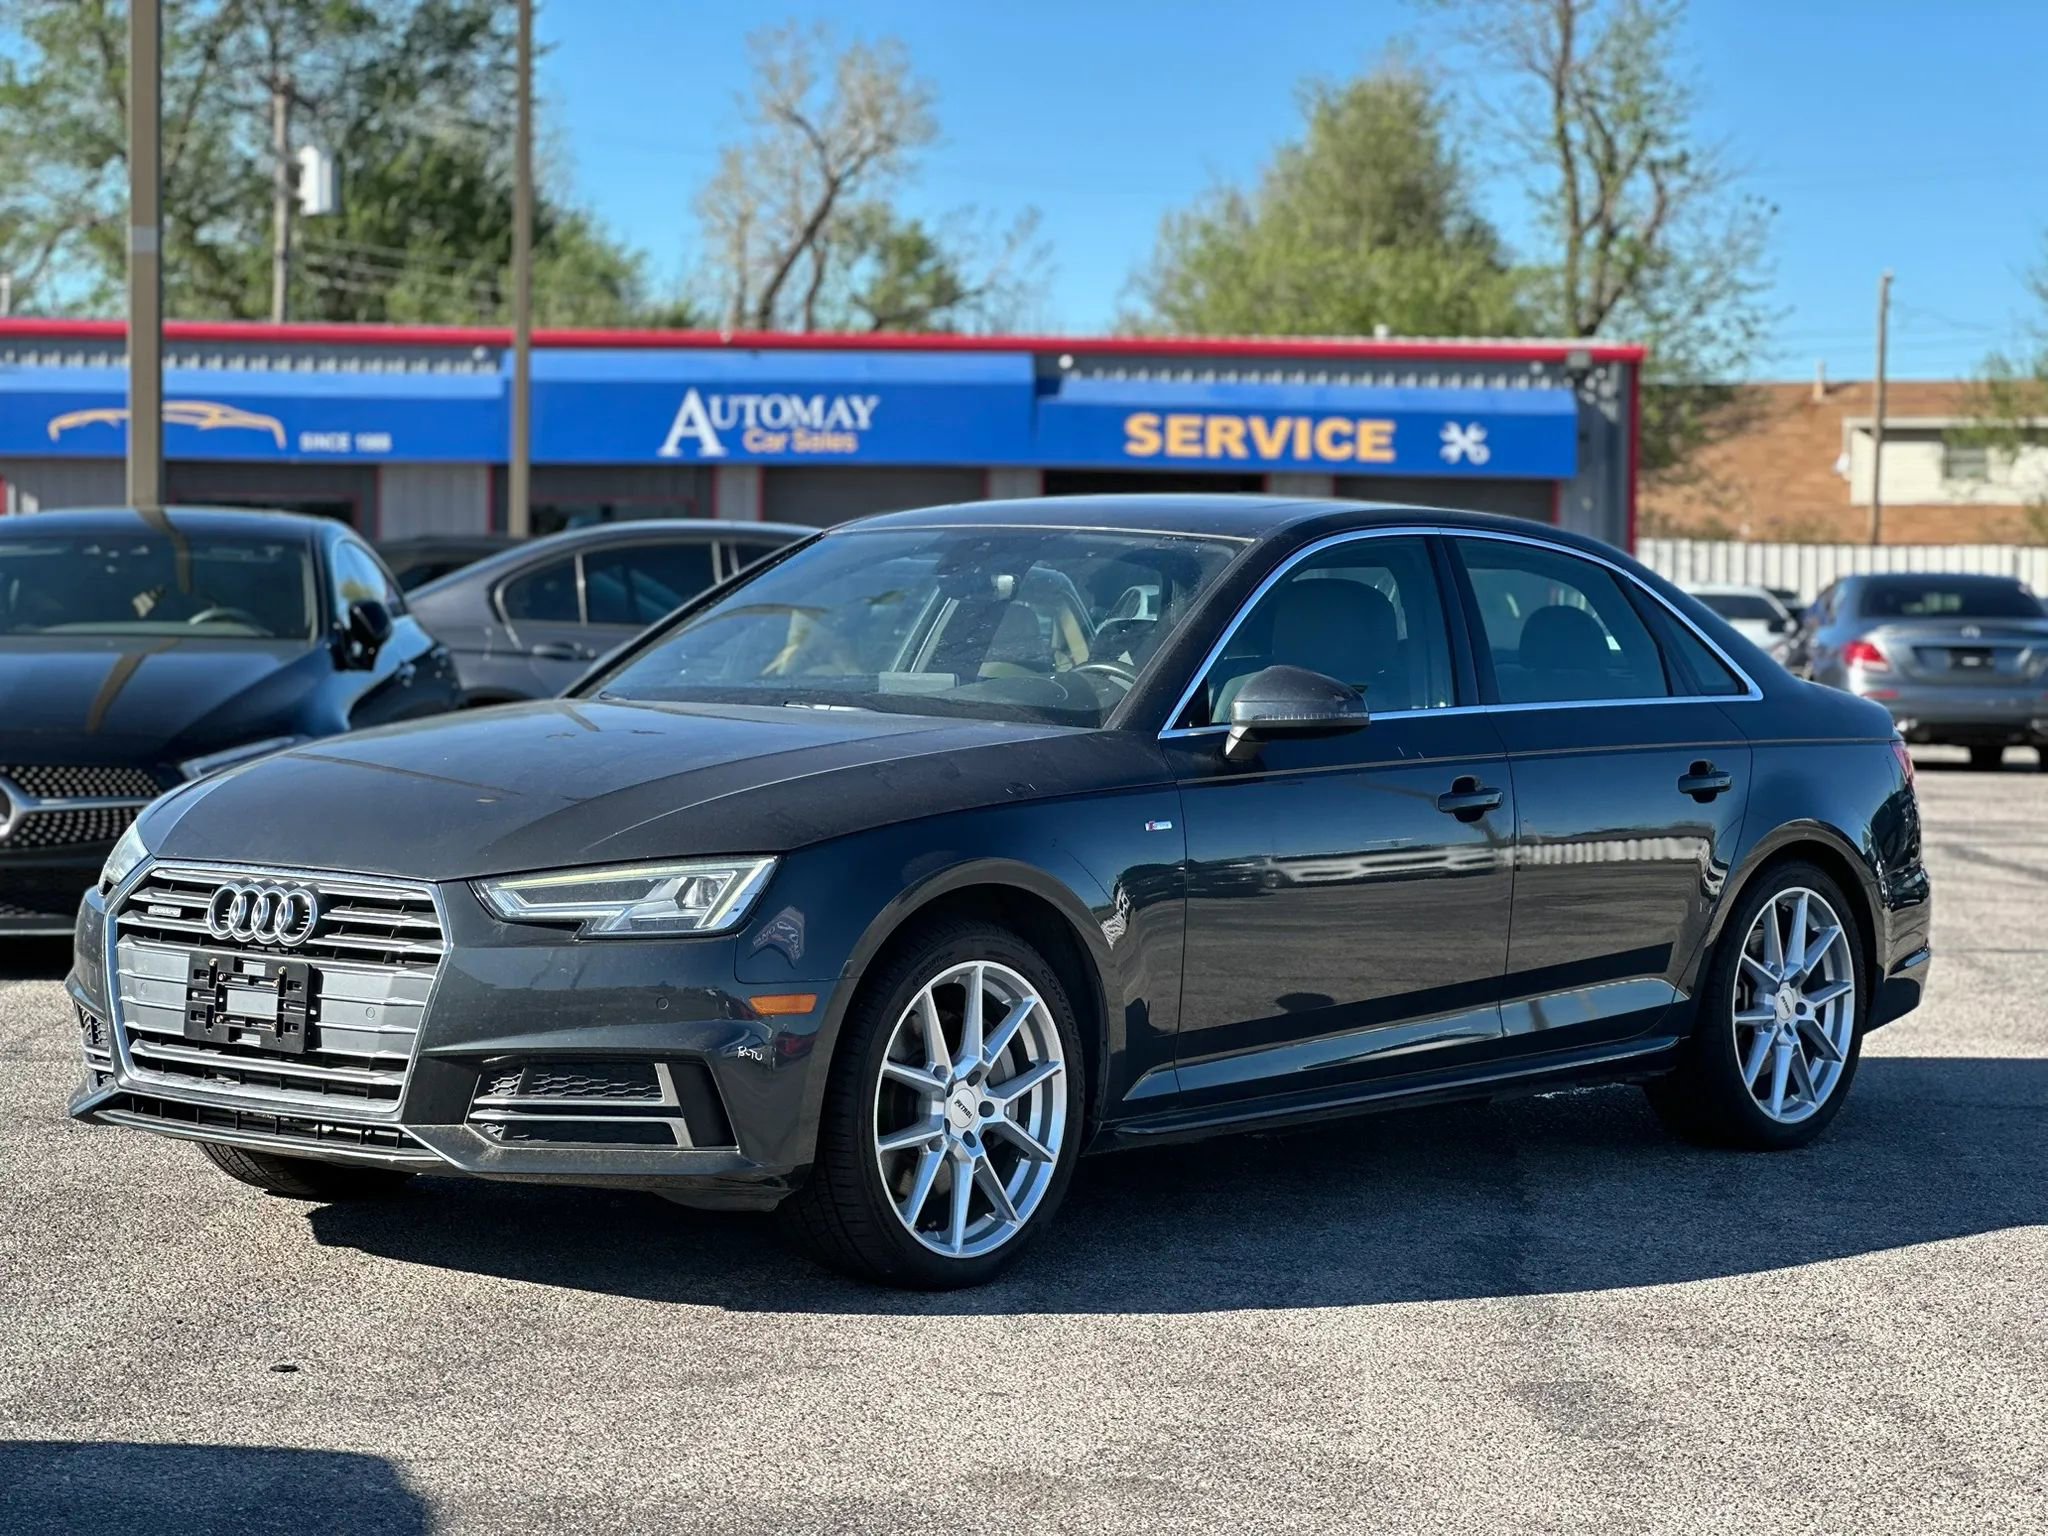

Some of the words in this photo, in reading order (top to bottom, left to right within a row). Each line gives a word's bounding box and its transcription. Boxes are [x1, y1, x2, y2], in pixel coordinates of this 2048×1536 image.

[658, 387, 879, 457] AUTOMAY
[742, 430, 787, 453] Car
[791, 428, 858, 453] Sales
[1125, 413, 1396, 463] SERVICE
[299, 431, 350, 453] SINCE
